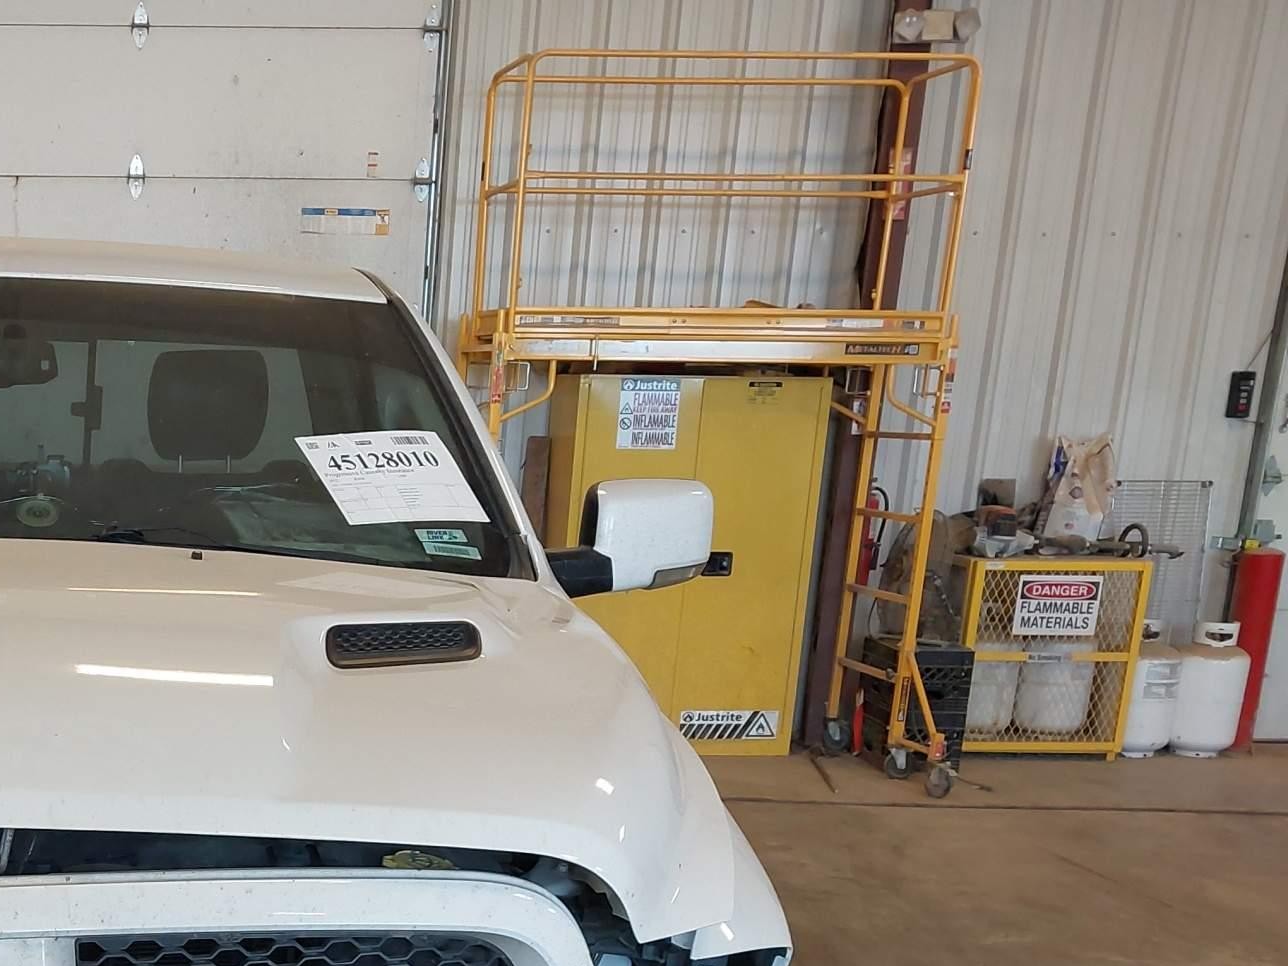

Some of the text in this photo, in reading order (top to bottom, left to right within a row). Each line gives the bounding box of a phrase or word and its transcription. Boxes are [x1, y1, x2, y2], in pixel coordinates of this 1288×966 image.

[635, 380, 678, 391] Justrite
[633, 392, 679, 407] FLAMMABLE
[633, 414, 677, 429] INFLAMABLE
[631, 431, 674, 446] INFLAMMABLE
[328, 451, 440, 471] 45128010
[1032, 585, 1089, 597] DANGER
[1020, 601, 1095, 615] FLAMMABLE
[1020, 616, 1089, 630] MATERIALS
[696, 712, 742, 722] Justrite
